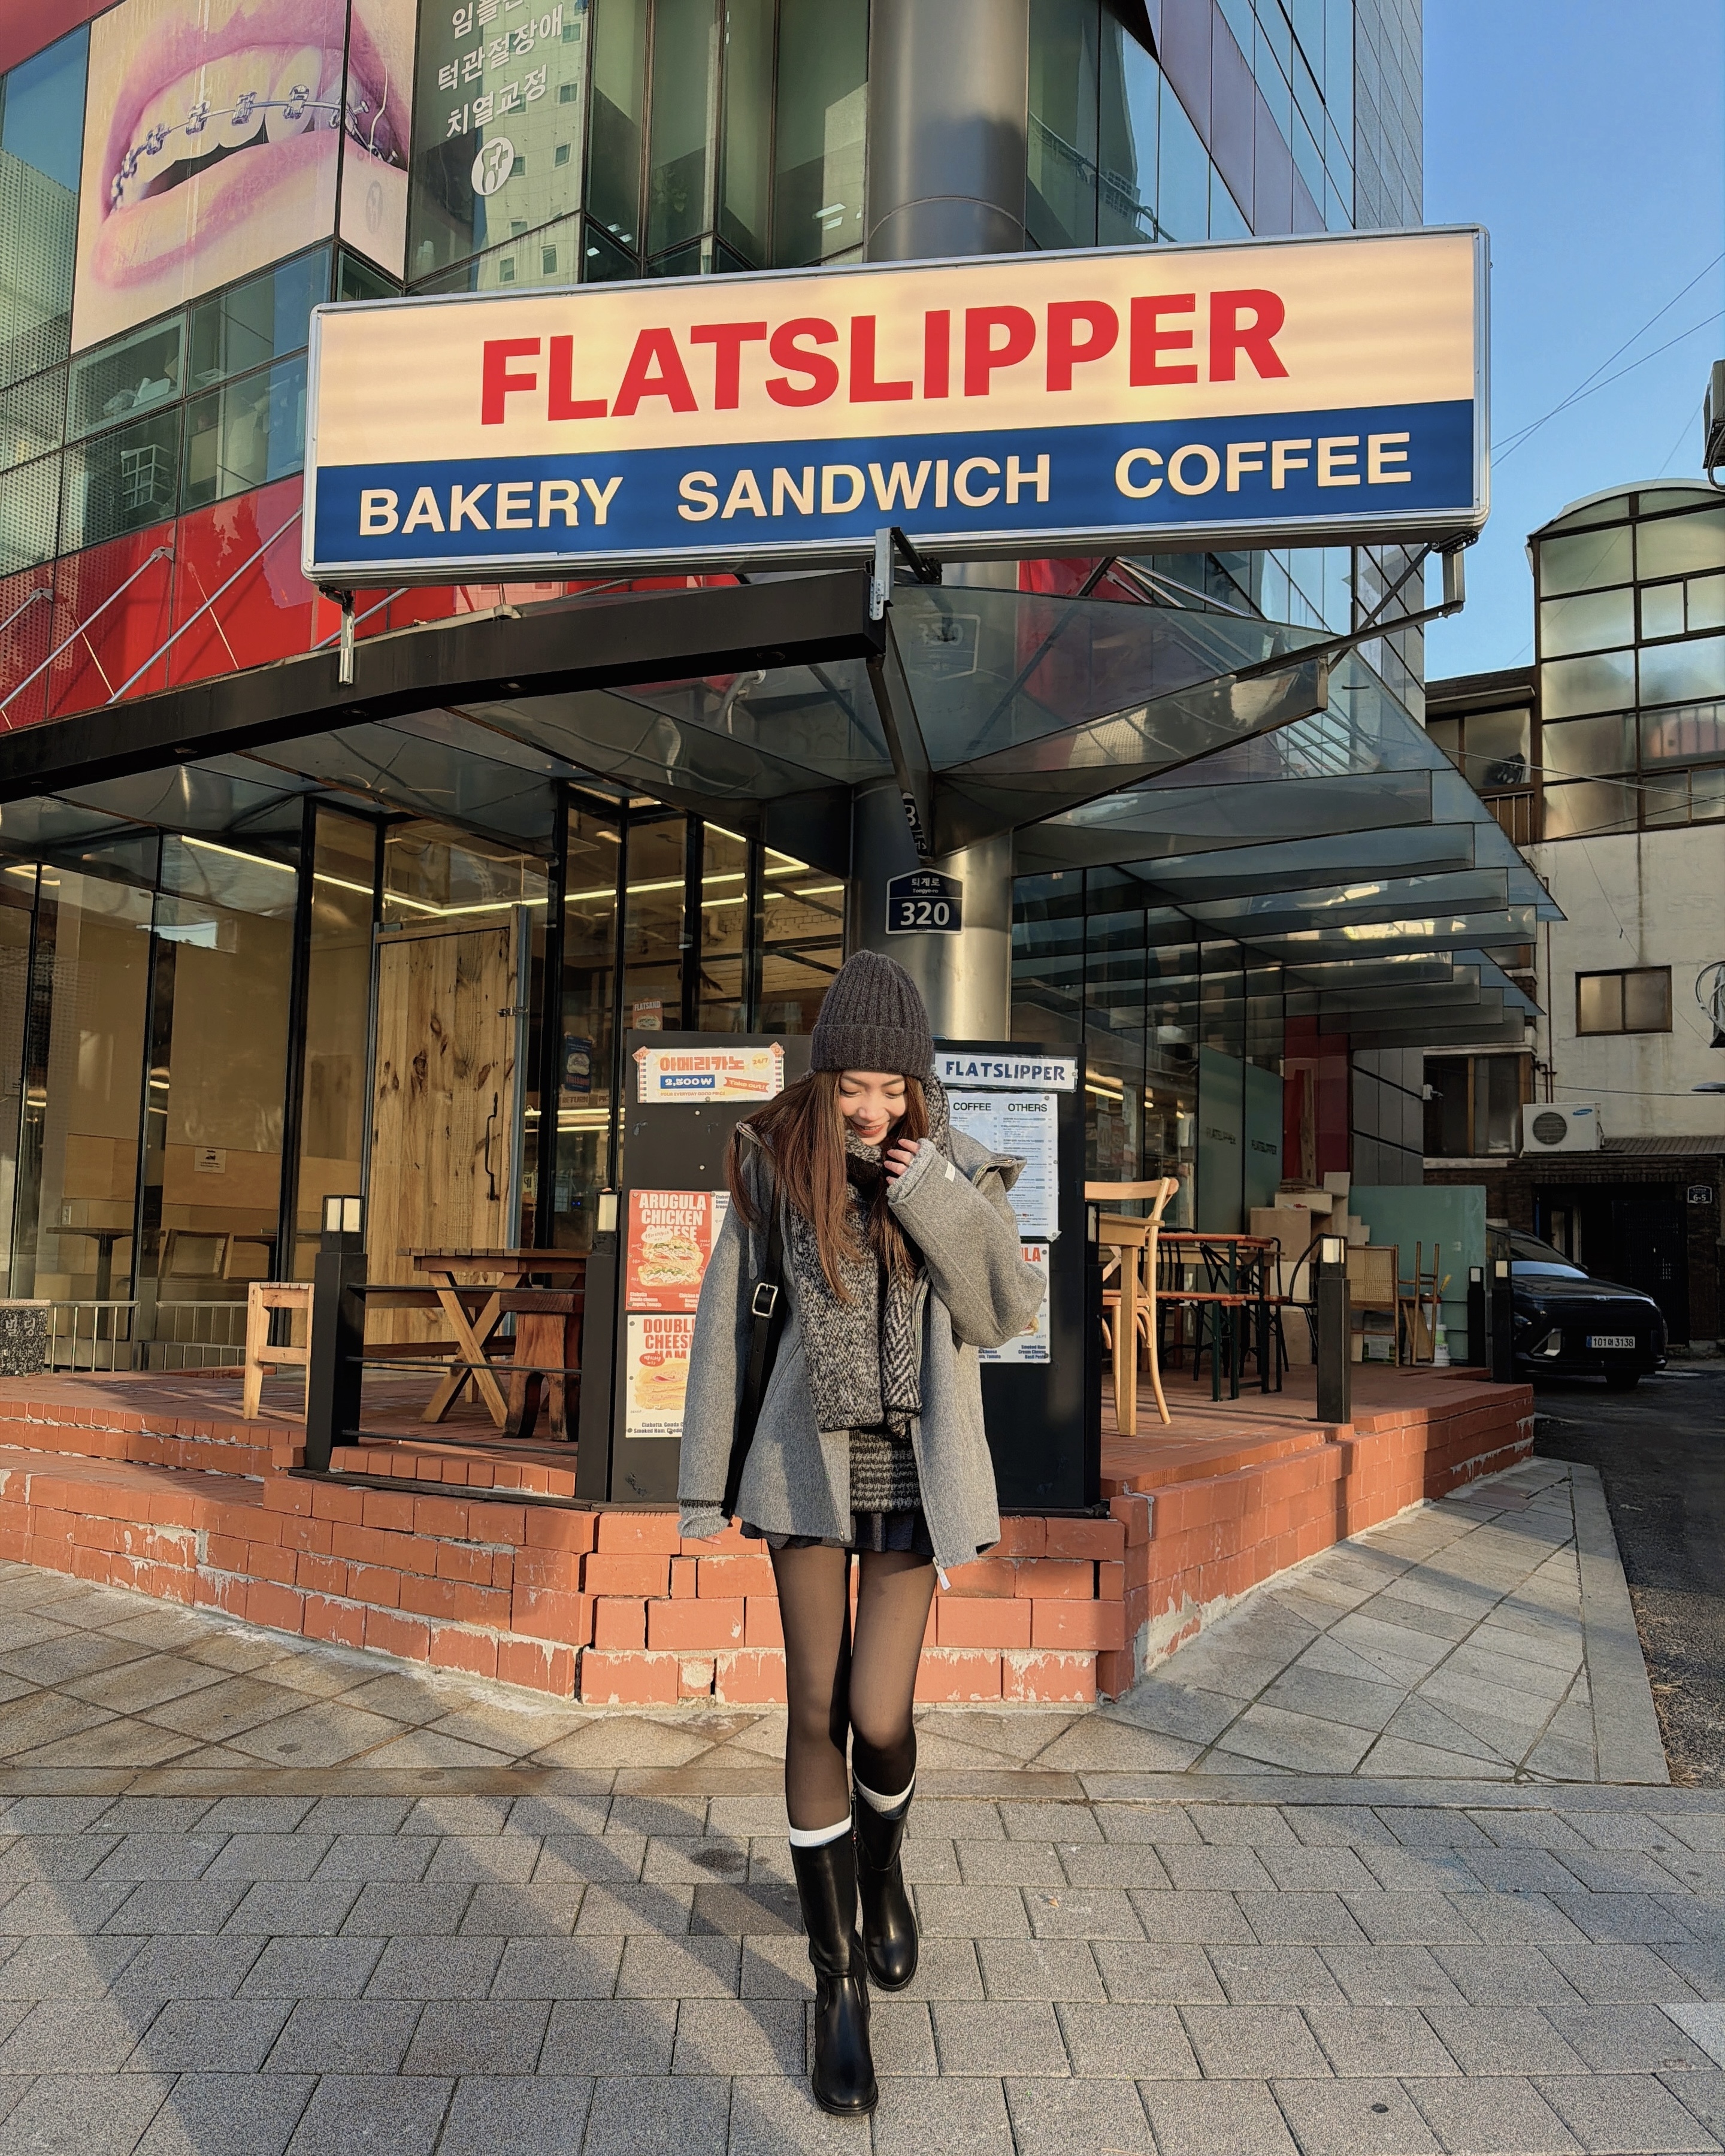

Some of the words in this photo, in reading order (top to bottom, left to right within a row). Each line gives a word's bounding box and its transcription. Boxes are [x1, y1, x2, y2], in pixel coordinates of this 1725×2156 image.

[452, 0, 523, 40] 임플
[438, 4, 563, 90] 턱관절장애
[446, 64, 546, 138] 치열교정
[481, 289, 1290, 425] FLATSLIPPER
[359, 477, 623, 535] BAKERY
[677, 453, 1050, 521] SANDWICH
[1115, 432, 1412, 498] COFFEE
[911, 877, 941, 887] 퇴계로
[900, 901, 950, 926] 320
[634, 1001, 661, 1011] FLATSAND
[659, 1056, 745, 1071] 아메리카노
[946, 1061, 1065, 1080] FLATSLIPPER
[953, 1102, 992, 1111] COFFEE
[1007, 1103, 1048, 1112] OTHERS
[639, 1193, 706, 1210] ARUGULA
[641, 1209, 703, 1226] CHICKEN
[5, 1316, 36, 1337] 빌딩
